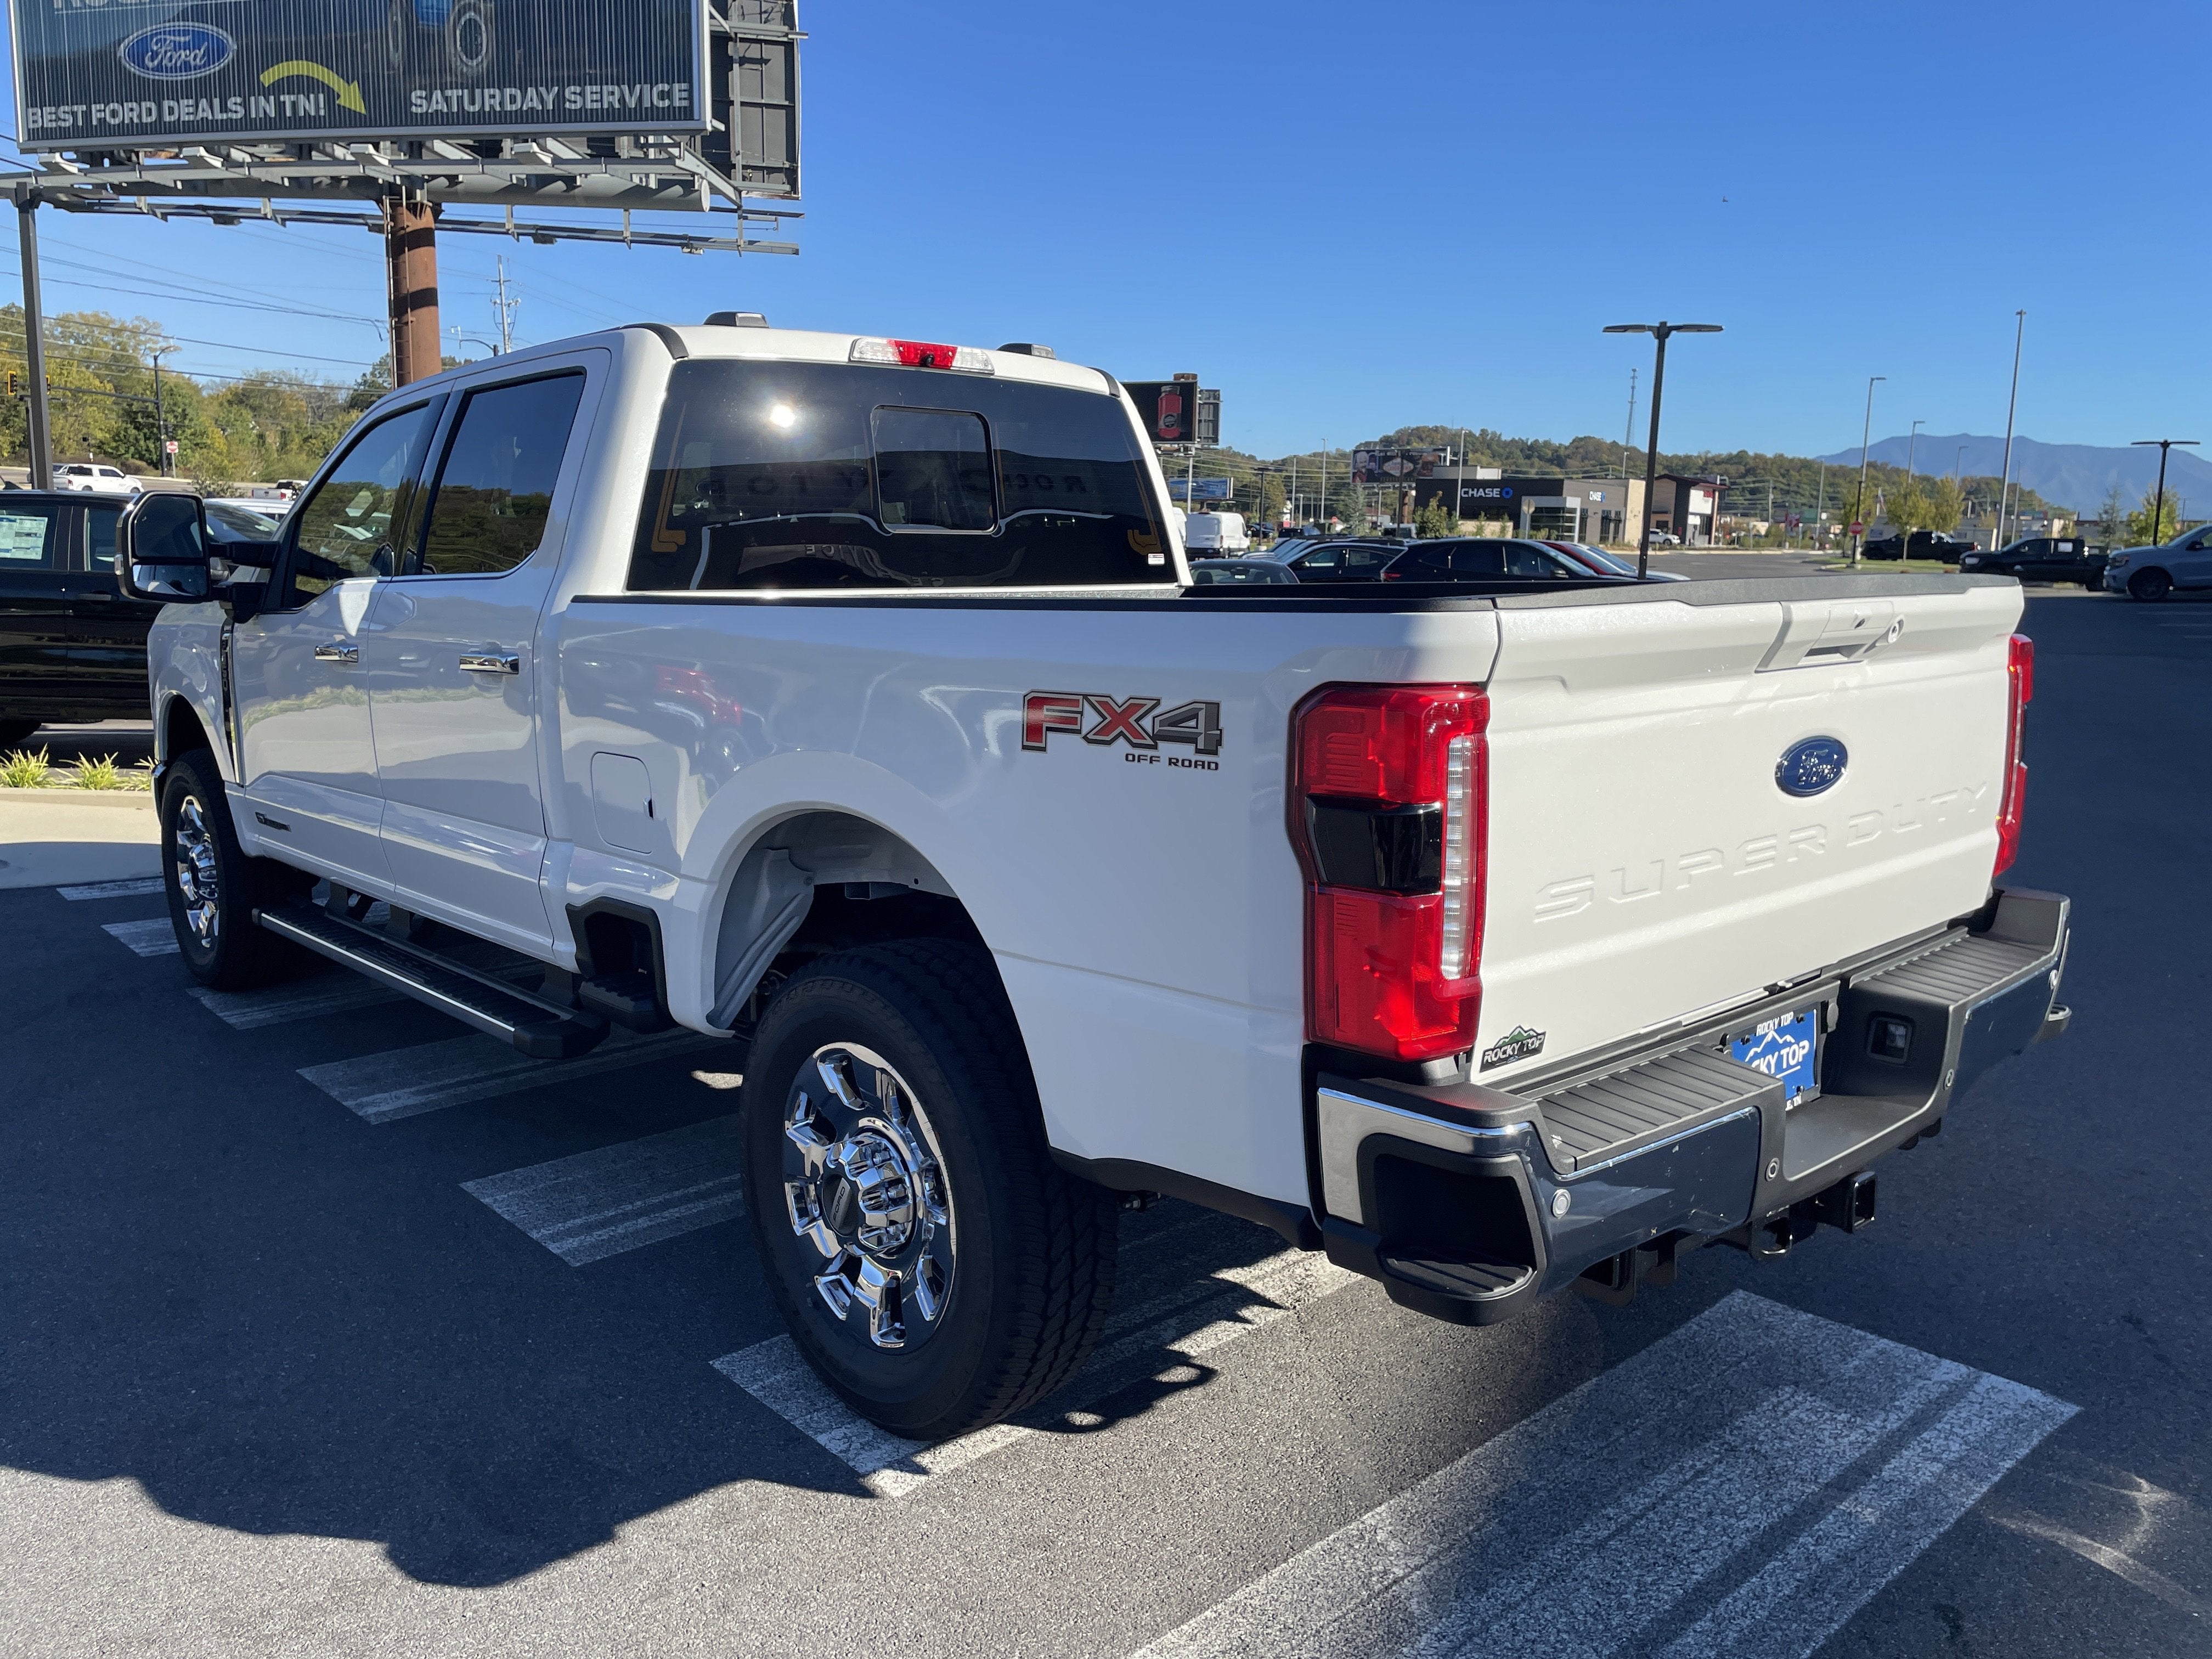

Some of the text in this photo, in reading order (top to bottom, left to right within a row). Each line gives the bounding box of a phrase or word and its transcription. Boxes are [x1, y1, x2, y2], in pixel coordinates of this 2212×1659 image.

[145, 35, 208, 67] Ford
[27, 93, 325, 129] BEST FORD DEALS IN TN!
[410, 83, 690, 113] SATURDAY SERVICE
[1461, 488, 1501, 498] CHASE
[1022, 689, 1224, 757] FX4
[1125, 753, 1219, 771] OFF ROAD
[1534, 782, 1987, 923] SUPER DUTY
[1756, 1011, 1795, 1036] ROCKY TOP
[1484, 1042, 1522, 1064] ROCKY
[1523, 1034, 1545, 1052] TOP
[1780, 1040, 1809, 1069] TOP
[833, 1186, 845, 1222] FORD
